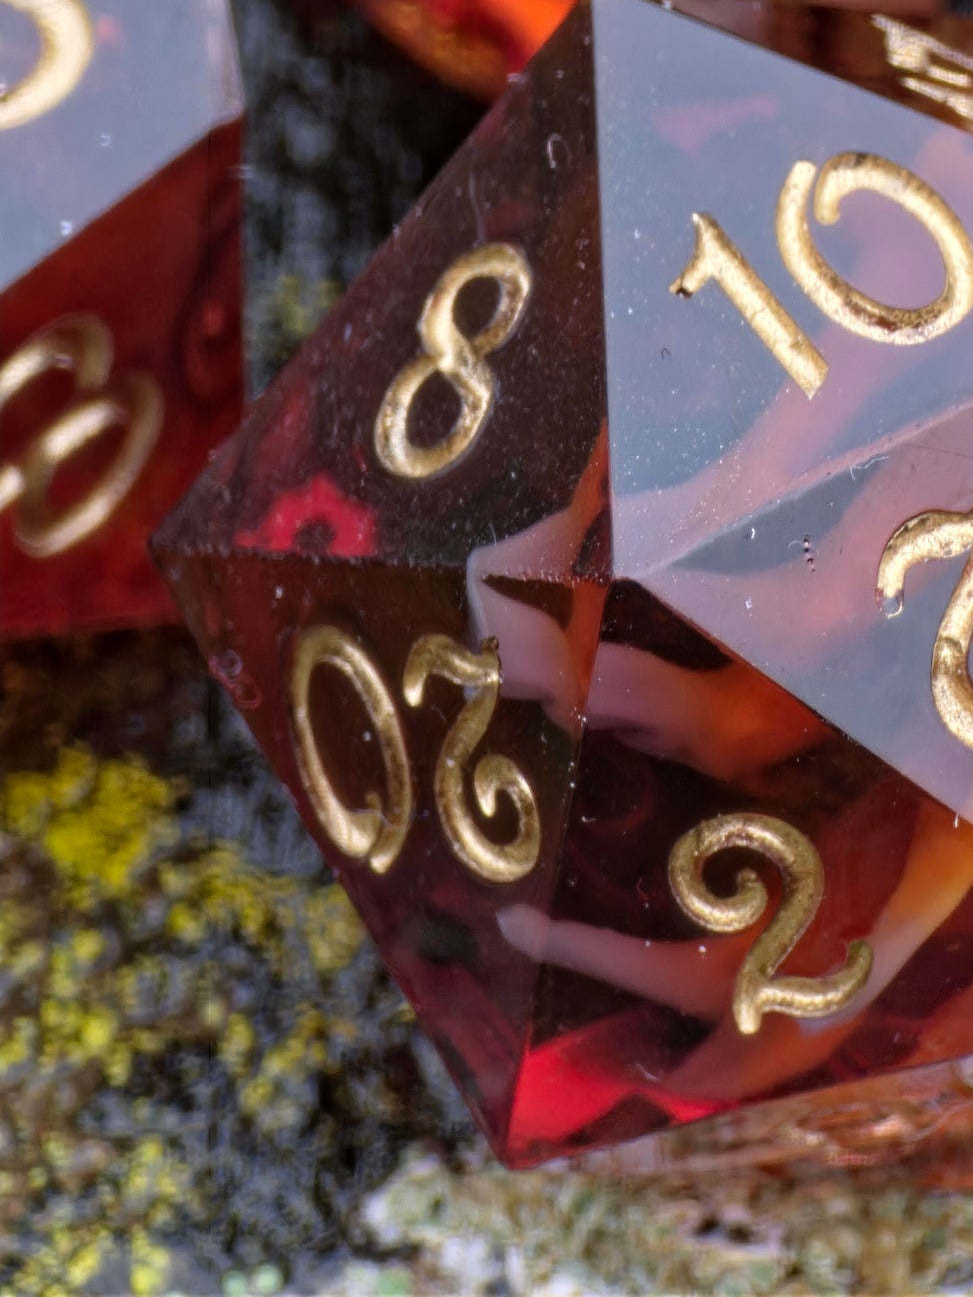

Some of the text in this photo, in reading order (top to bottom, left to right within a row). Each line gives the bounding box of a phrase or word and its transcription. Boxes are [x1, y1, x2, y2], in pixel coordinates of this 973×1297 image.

[373, 241, 534, 481] 8
[290, 623, 541, 884] 20
[668, 813, 873, 1036] 2
